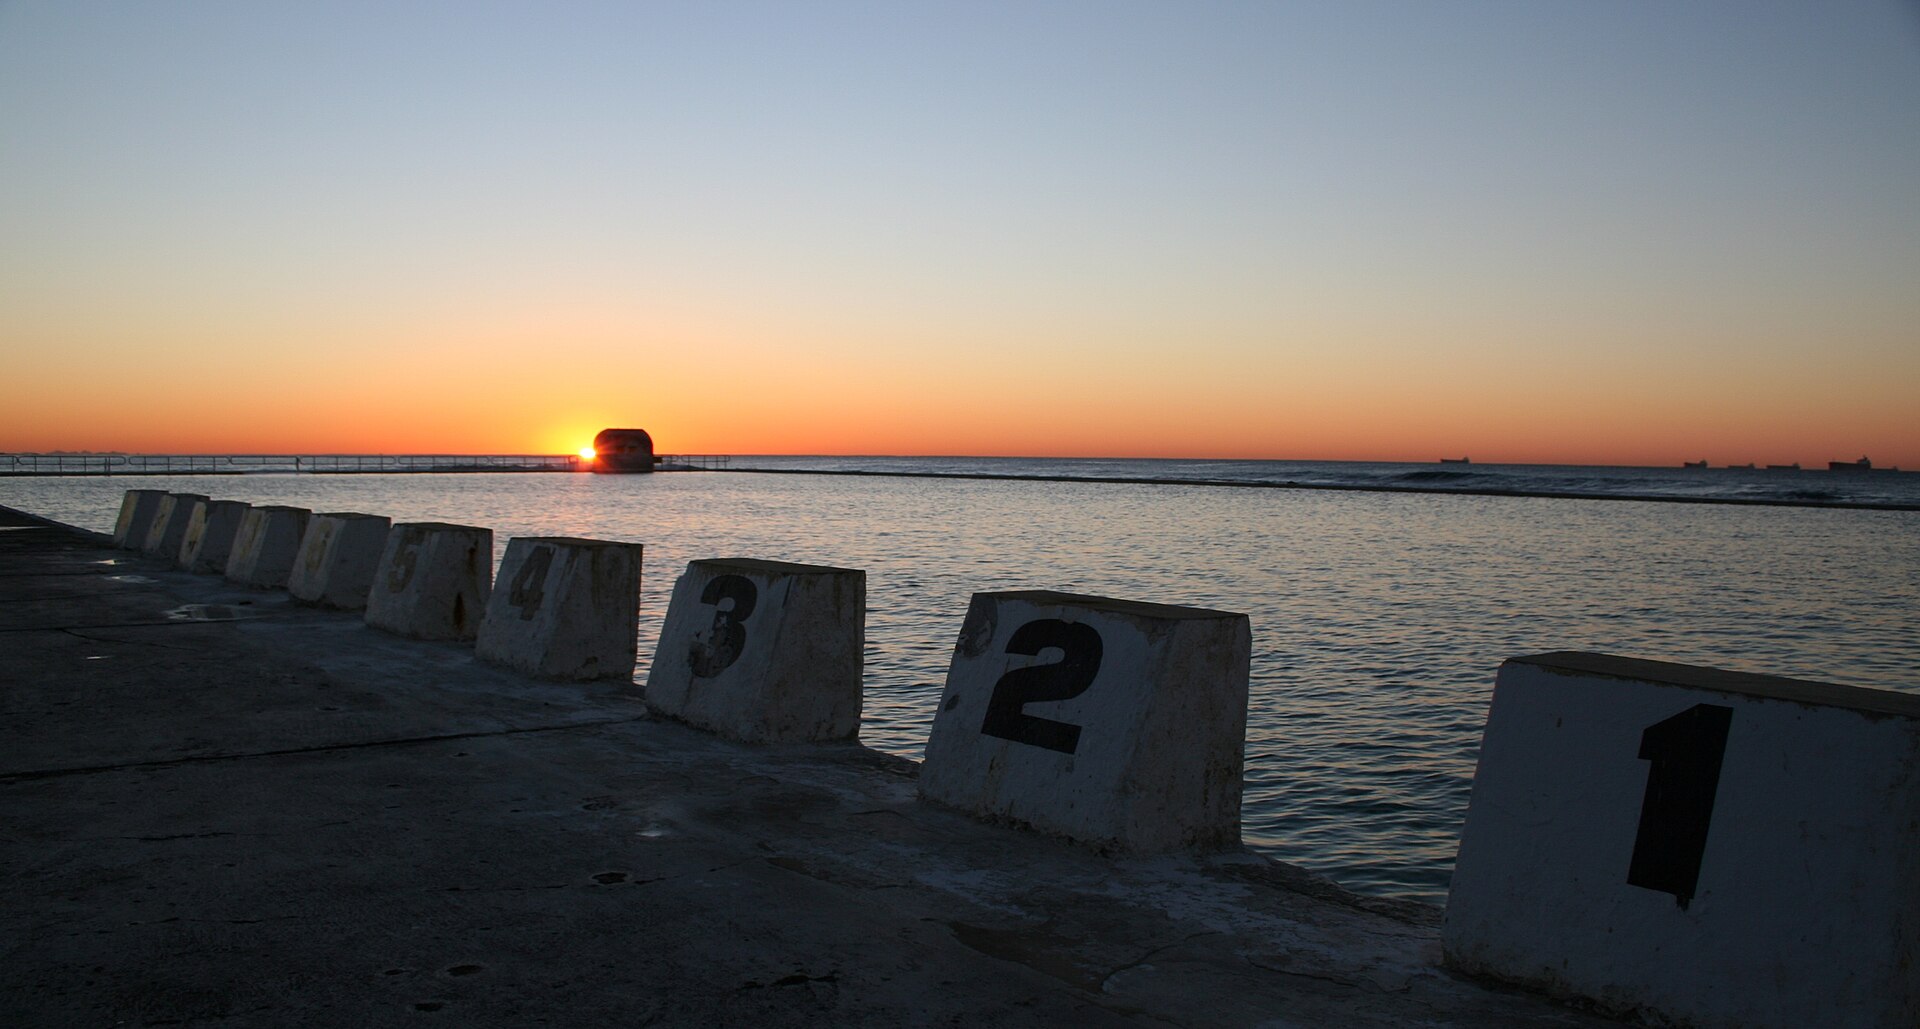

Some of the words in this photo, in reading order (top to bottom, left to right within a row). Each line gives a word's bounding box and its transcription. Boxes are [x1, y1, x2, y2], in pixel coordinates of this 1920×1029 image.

[387, 530, 426, 593] 5
[509, 546, 556, 620] 4
[687, 574, 758, 679] 3
[981, 618, 1104, 756] 2
[1626, 703, 1734, 910] 1
